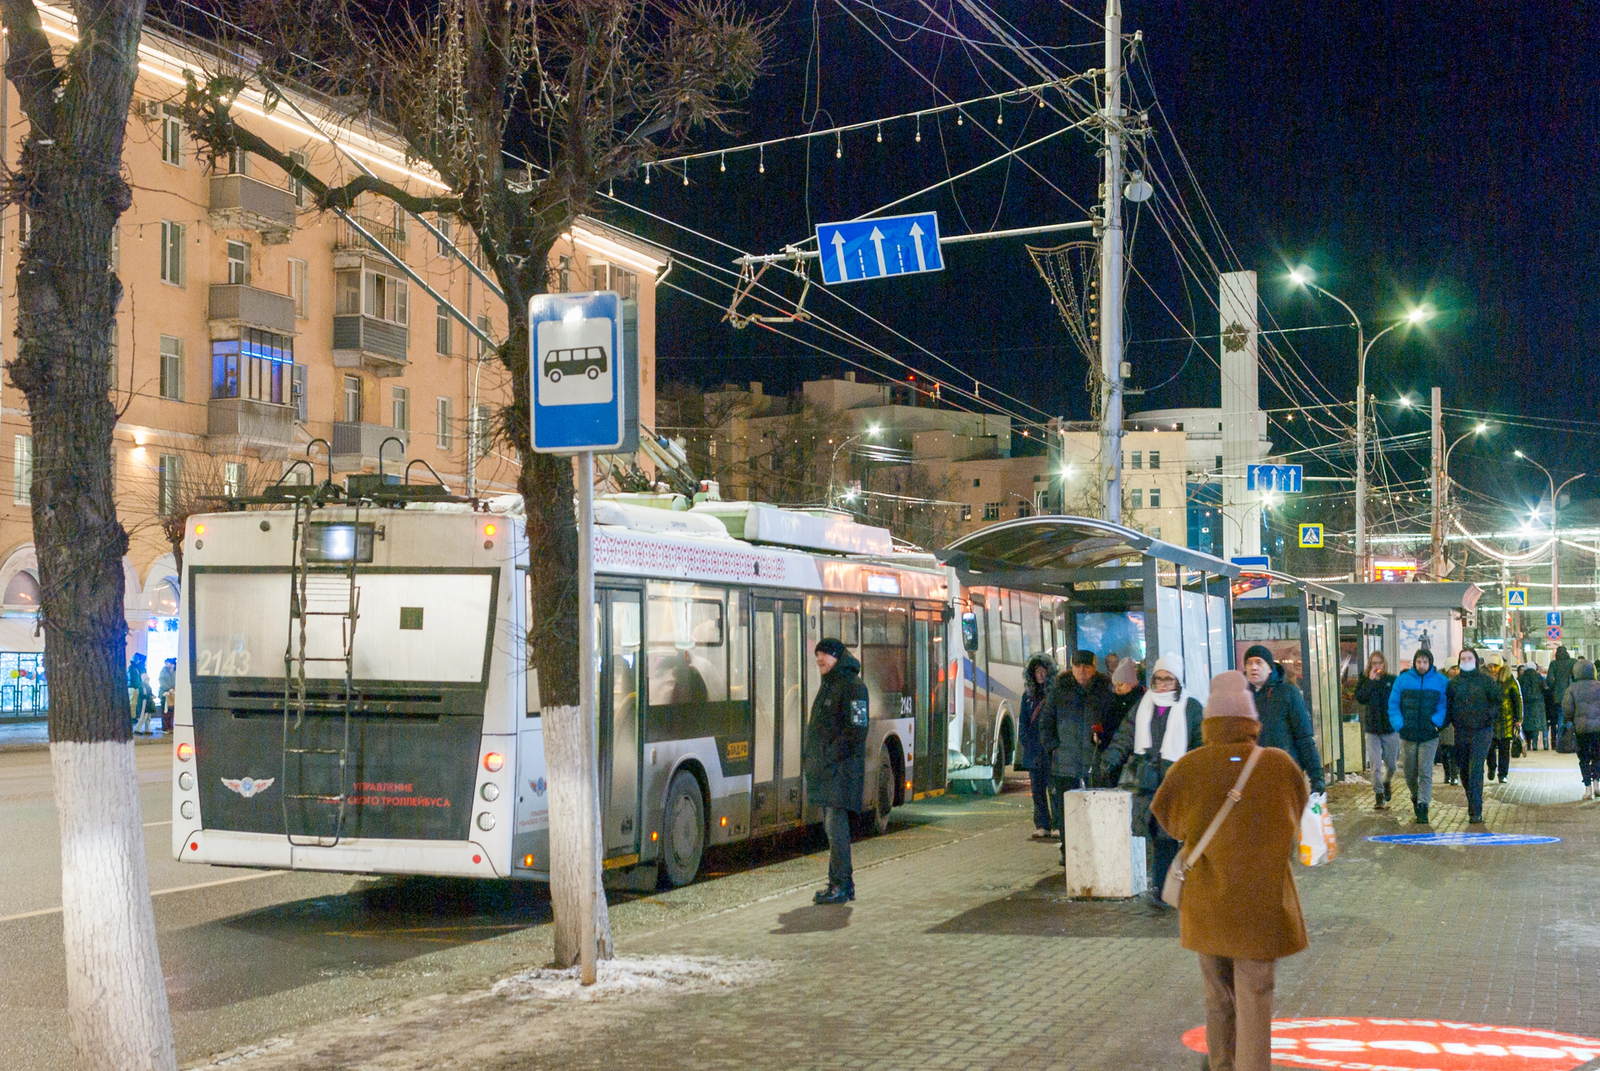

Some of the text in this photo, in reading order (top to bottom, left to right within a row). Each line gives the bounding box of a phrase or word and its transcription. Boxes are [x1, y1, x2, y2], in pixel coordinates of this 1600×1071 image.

[197, 649, 251, 676] 2143
[900, 696, 912, 715] 2143
[353, 782, 413, 793] УПРАВЛЕНИЕ
[382, 795, 451, 808] ТРОЛЛЕЙБУСА
